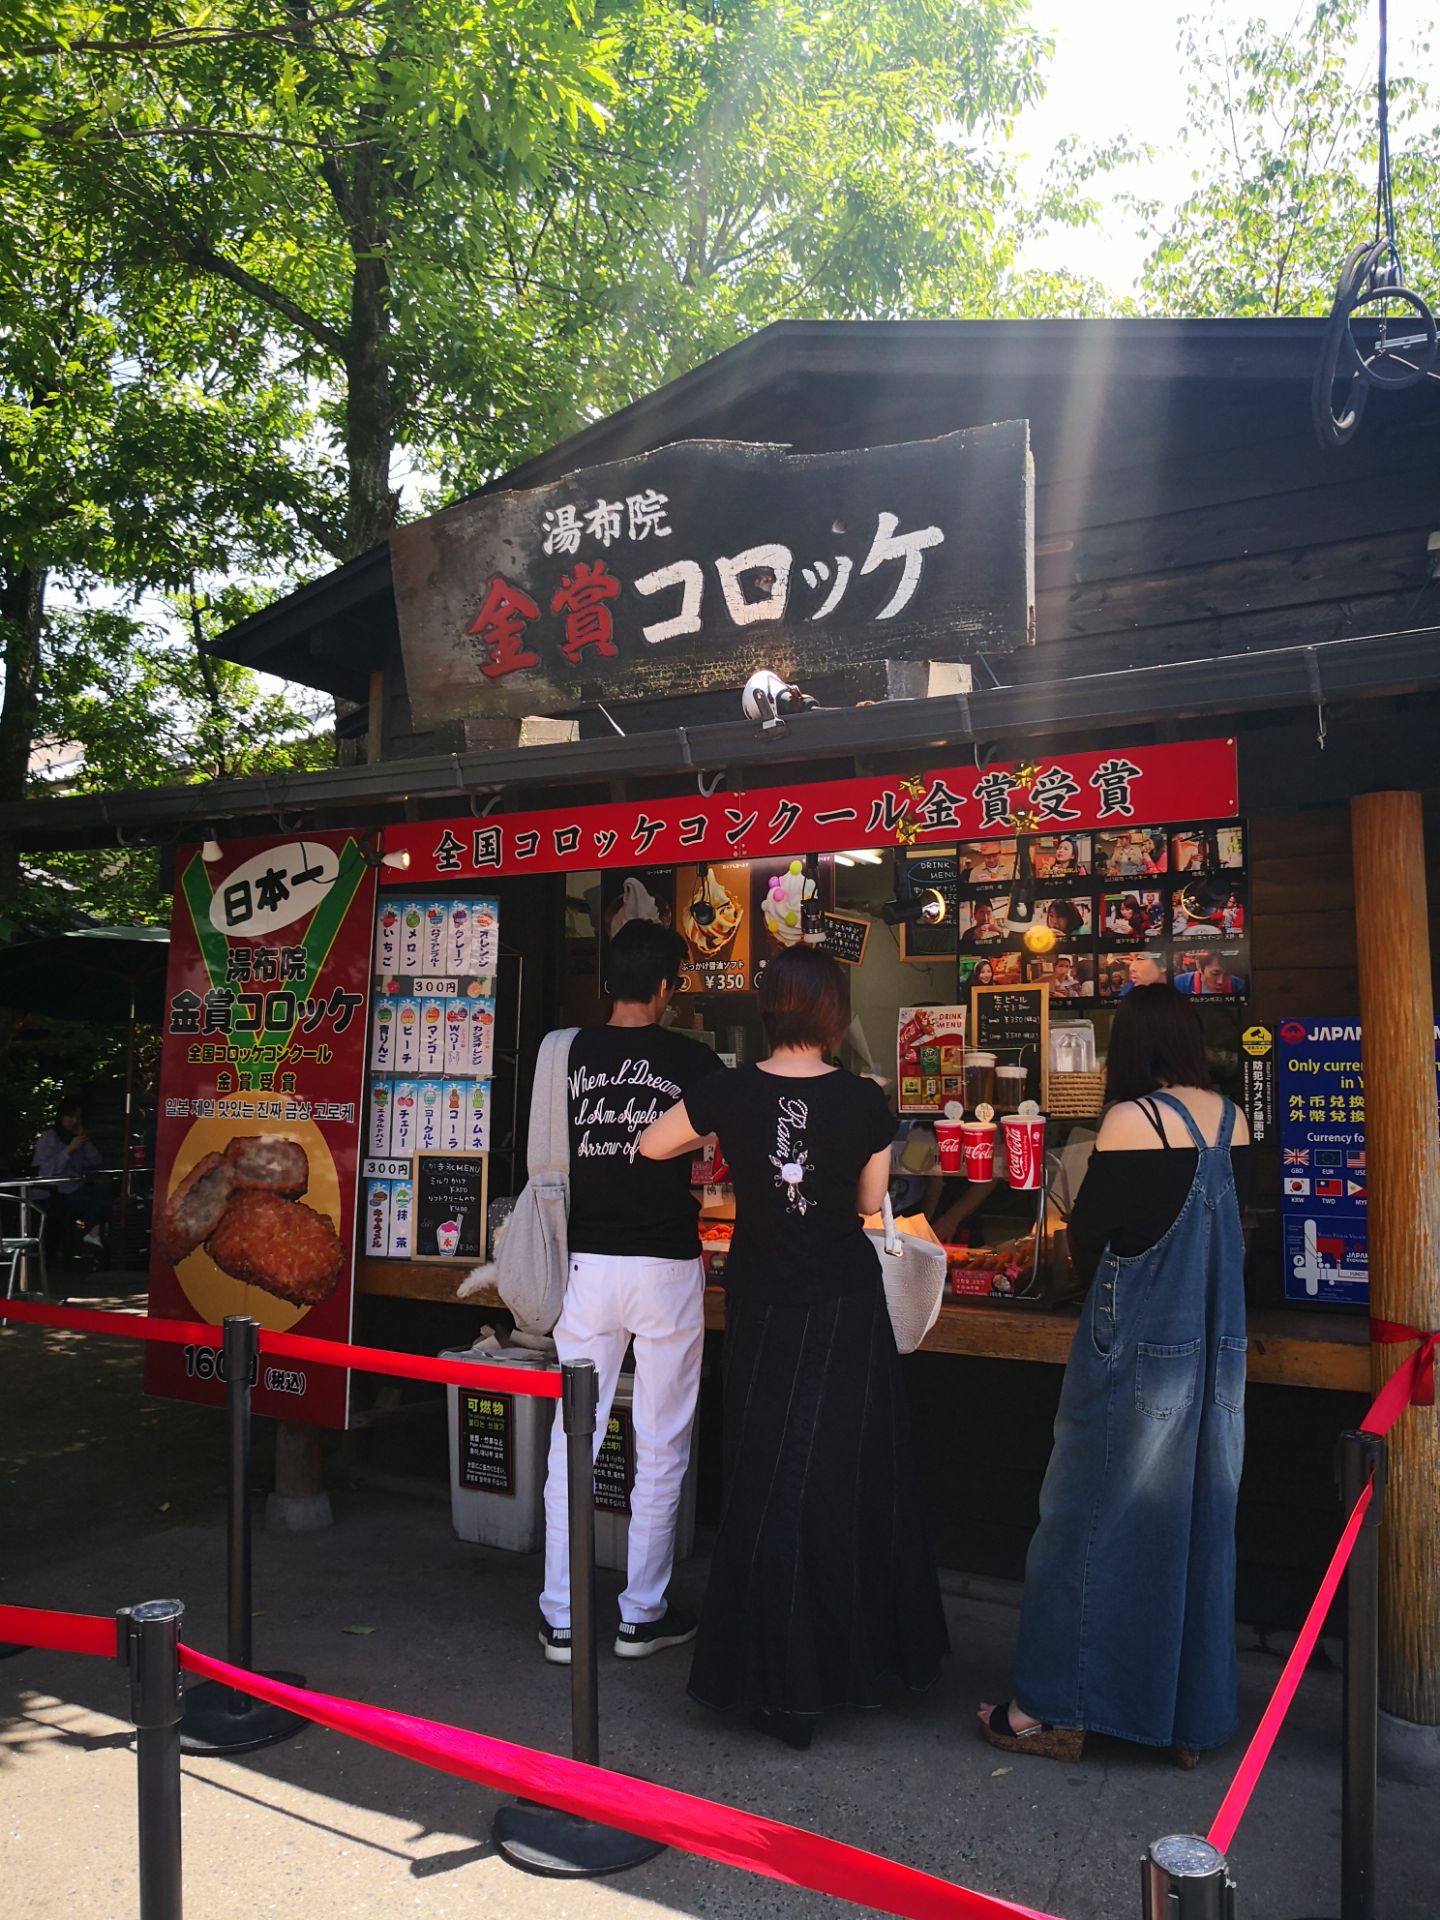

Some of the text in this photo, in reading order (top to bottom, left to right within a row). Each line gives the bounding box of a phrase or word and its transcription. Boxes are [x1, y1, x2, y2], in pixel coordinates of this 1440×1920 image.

[541, 488, 674, 558] 湯布院
[466, 511, 945, 679] 金賞コロッケ
[920, 861, 950, 870] DRINK
[930, 871, 957, 880] MENU
[224, 865, 324, 927] 日本一
[226, 945, 307, 984] 湯布院
[382, 929, 394, 967] いちご
[406, 929, 417, 967] メロン
[415, 981, 456, 993] 300円
[705, 974, 745, 990] ¥350
[169, 986, 363, 1035] 金賞コロッケ
[939, 1013, 962, 1021] DRINK
[188, 1044, 332, 1064] 全国コロッケコンクール
[402, 1025, 412, 1064] ピーチ
[427, 1025, 438, 1064] マンゴー
[217, 1072, 296, 1093] 金賞受賞
[568, 1065, 610, 1101] When
[627, 1059, 682, 1099] Dream
[1288, 1059, 1363, 1074] Only curre
[1341, 1076, 1354, 1089] in
[165, 1098, 354, 1124] 일본 제일 맛있는 진짜 금상 고로케
[587, 1097, 618, 1125] Am
[1253, 1060, 1264, 1142] 防犯カメラ録画中
[399, 1109, 409, 1148] チェリー
[423, 1109, 433, 1148] ヨーグルト
[448, 1110, 458, 1148] コーラ
[472, 1110, 483, 1148] ラムネ
[1307, 1132, 1352, 1145] Currency
[578, 1130, 641, 1164] Arrow of
[367, 1162, 408, 1175] 300円
[396, 1210, 408, 1248] 抹茶
[264, 1367, 306, 1396] (税込)
[467, 1398, 504, 1417] 可燃物
